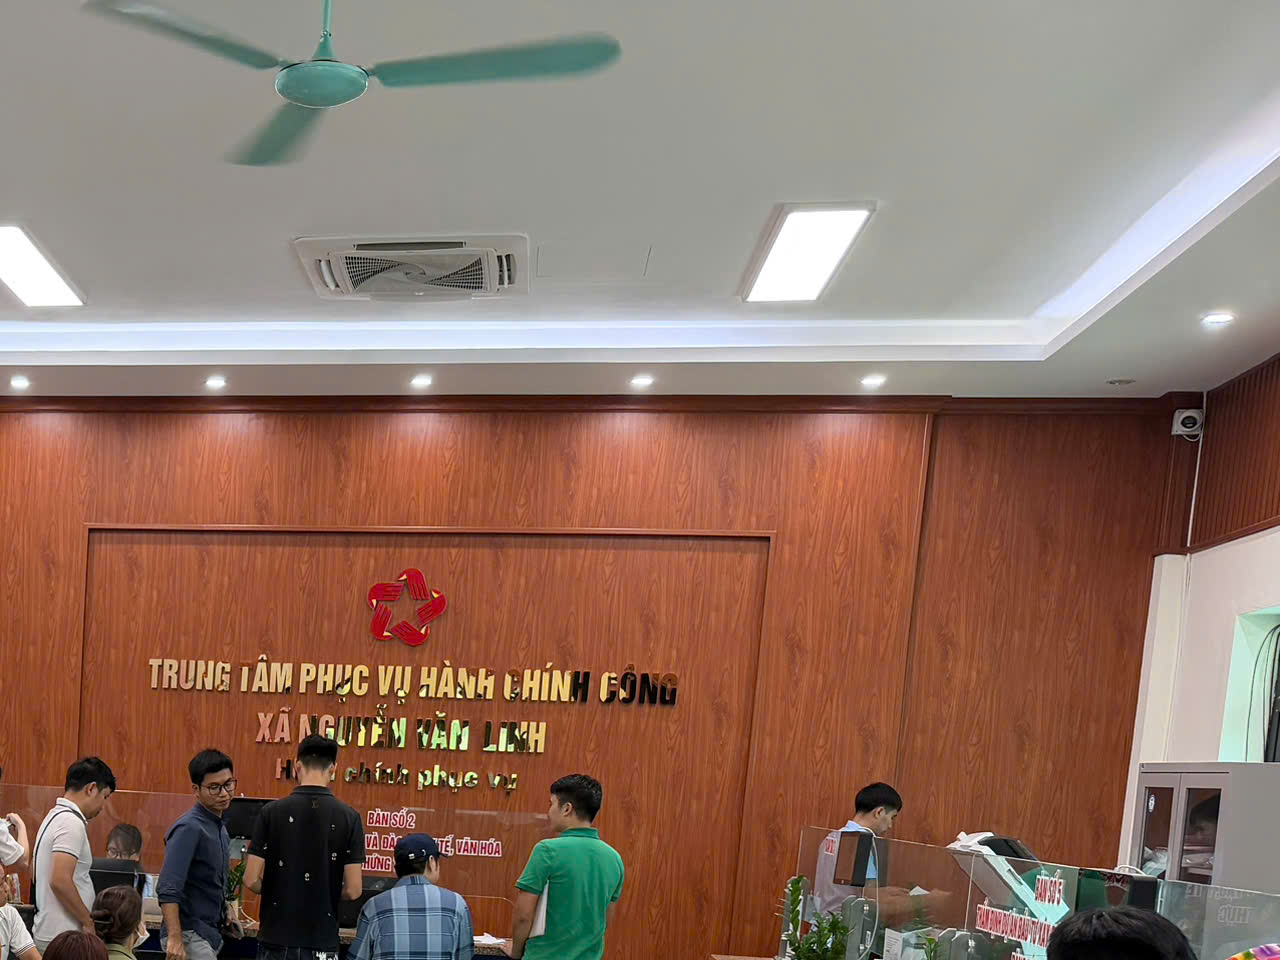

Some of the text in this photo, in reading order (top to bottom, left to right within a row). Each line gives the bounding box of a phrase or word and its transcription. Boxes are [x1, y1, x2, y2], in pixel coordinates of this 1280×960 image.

[149, 654, 679, 706] TRUNG TÂM PHỤC VỤ HÀNH CHÍNH CÔNG
[255, 703, 547, 753] XÃ NGUYỄN VĂN LINH
[344, 761, 518, 796] chính phục vụ
[367, 807, 416, 829] BÀN SỐ 2
[365, 832, 380, 850] VÀ
[456, 836, 477, 855] VĂN
[479, 838, 502, 857] HÓA
[361, 853, 392, 872] HỨNG
